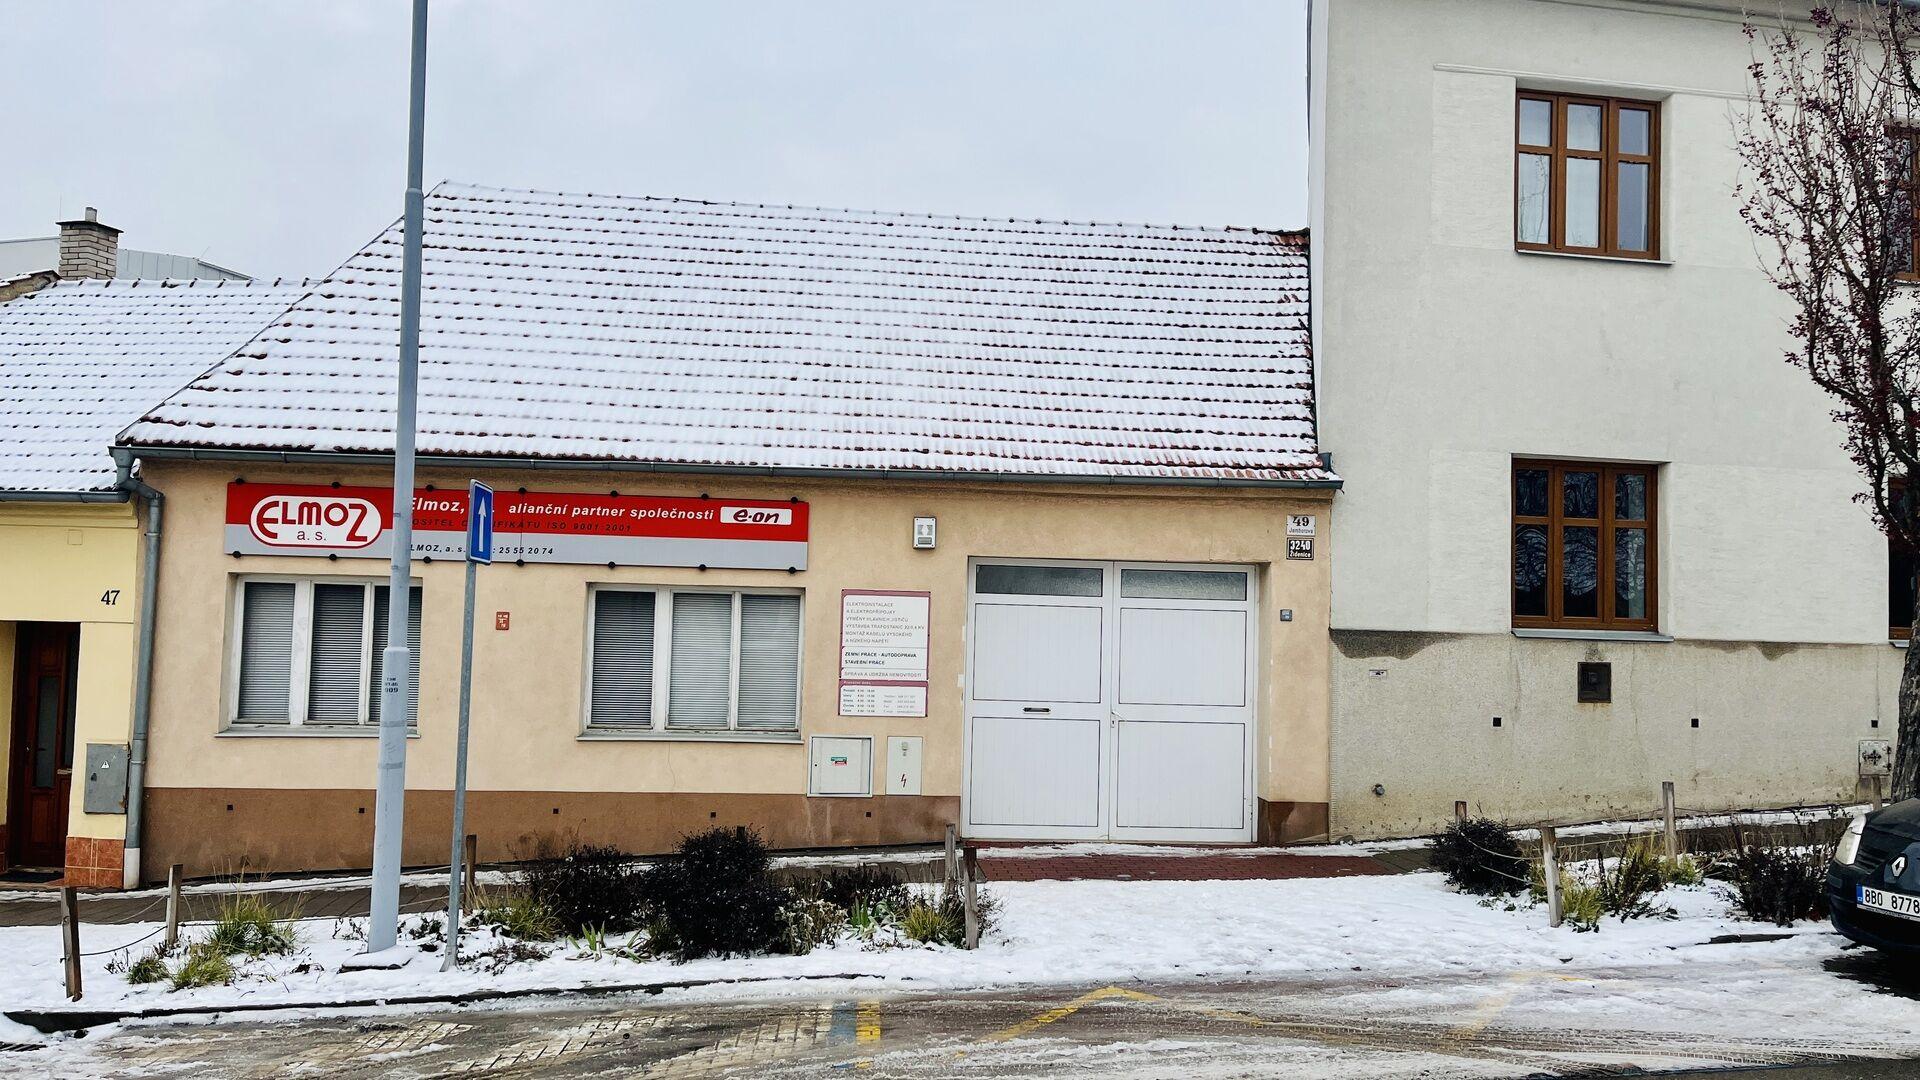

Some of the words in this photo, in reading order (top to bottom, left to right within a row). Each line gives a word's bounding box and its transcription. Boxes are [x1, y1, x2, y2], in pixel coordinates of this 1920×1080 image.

[508, 503, 568, 515] alianční
[571, 505, 625, 518] partner
[629, 507, 714, 520] společnosti
[256, 500, 368, 542] ELMOZ
[412, 518, 455, 527] OSITEL
[1292, 516, 1310, 527] 49
[297, 530, 310, 541] a.
[315, 531, 326, 541] s.
[410, 544, 442, 553] LMOZ,
[498, 546, 510, 554] 25
[542, 547, 553, 555] 74
[1290, 540, 1311, 550] 3240
[100, 589, 121, 605] 47
[1891, 895, 1920, 914] 8778
